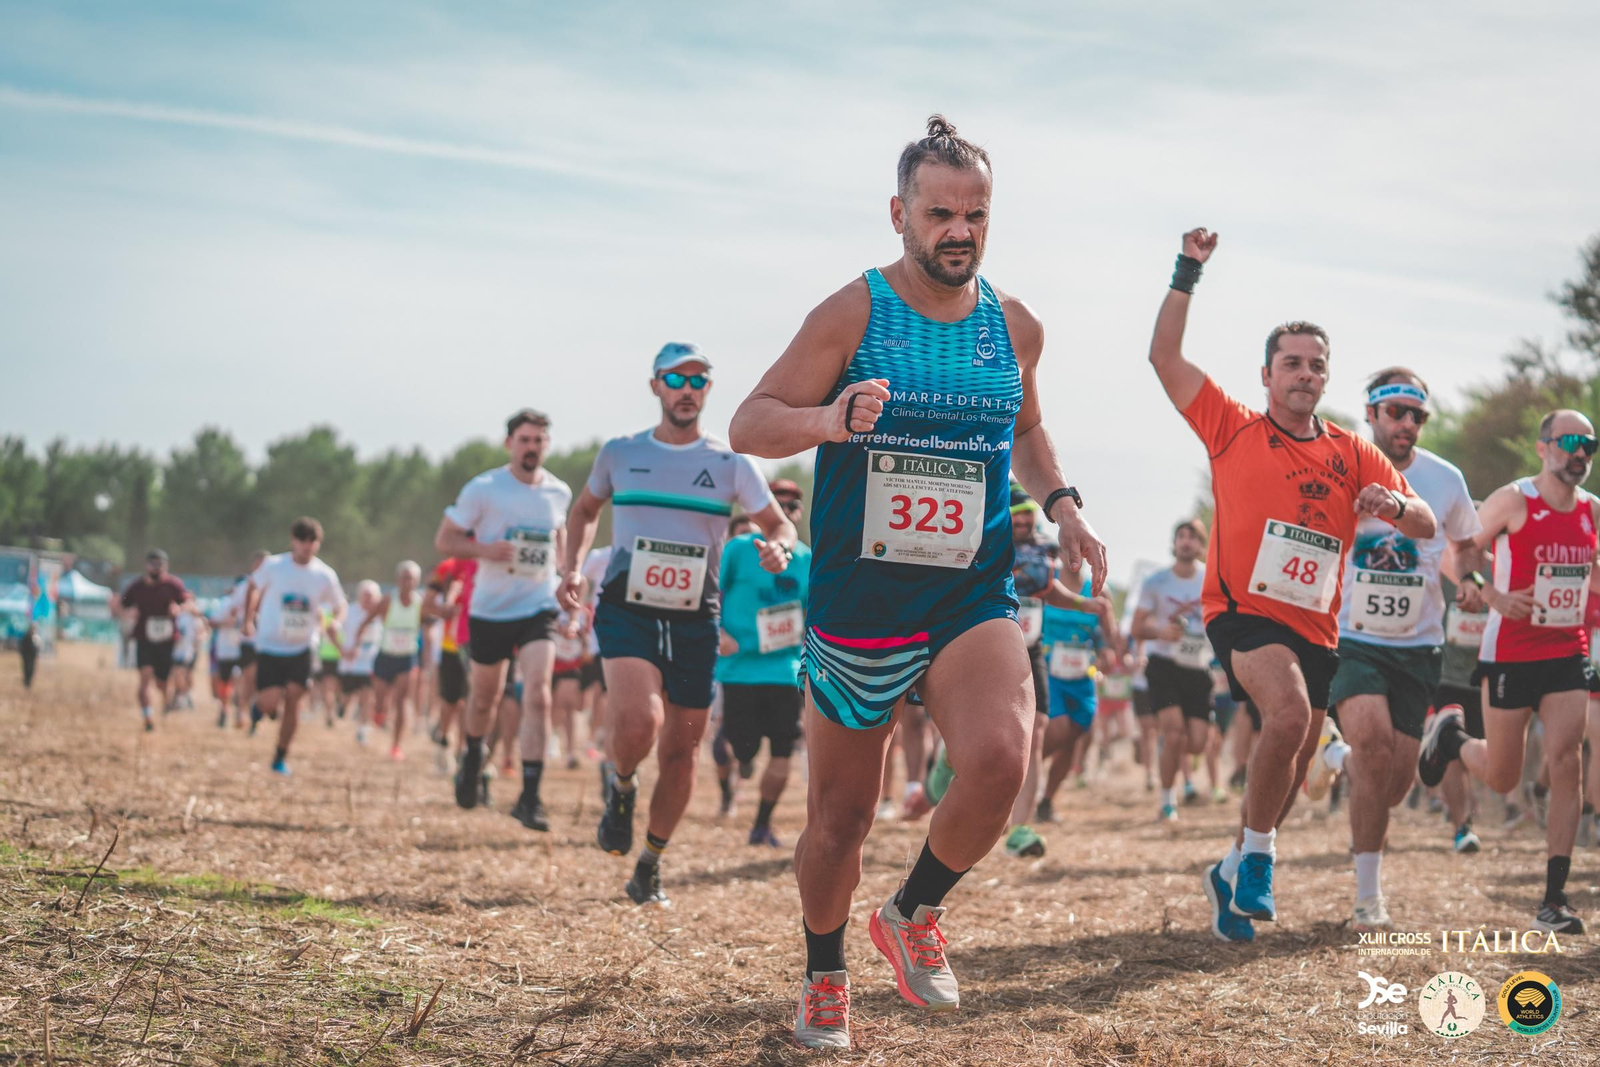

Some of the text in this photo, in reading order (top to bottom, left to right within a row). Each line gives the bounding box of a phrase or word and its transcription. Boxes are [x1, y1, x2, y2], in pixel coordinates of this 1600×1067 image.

[891, 407, 925, 418] Clínica
[927, 409, 959, 420] Dental
[961, 411, 978, 422] Los
[902, 458, 957, 476] ITÁLICA
[950, 482, 972, 490] MORENO
[888, 494, 964, 535] 323
[645, 565, 692, 590] 603
[1282, 555, 1319, 586] 48
[1366, 594, 1410, 617] 539
